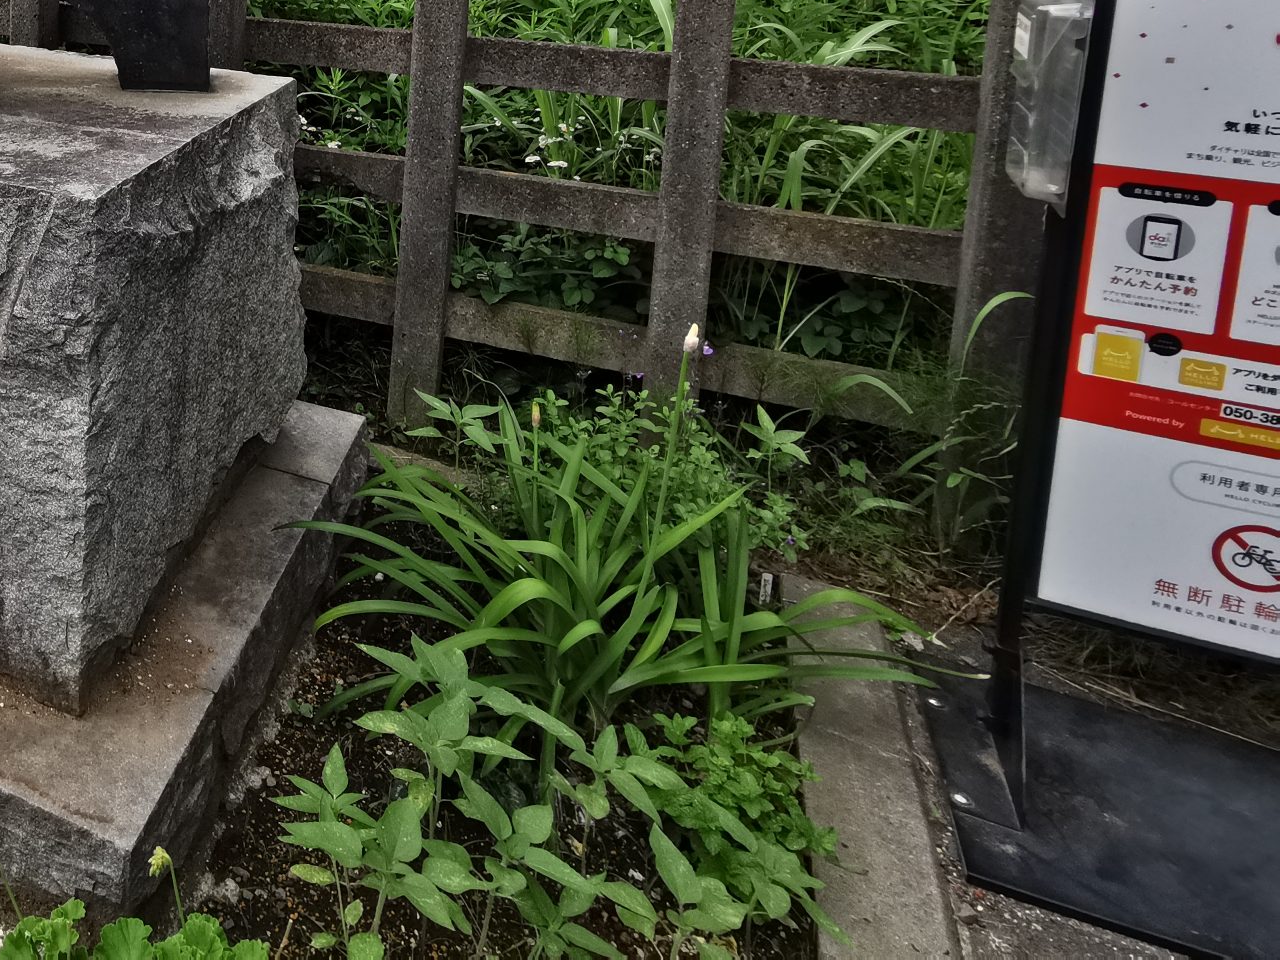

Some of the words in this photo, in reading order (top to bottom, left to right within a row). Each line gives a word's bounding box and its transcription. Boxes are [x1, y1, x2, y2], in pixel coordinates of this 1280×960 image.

[1110, 275, 1199, 297] かんたん予約
[1184, 371, 1219, 383] HELLO
[1125, 410, 1170, 425] Powered
[1172, 420, 1185, 429] by
